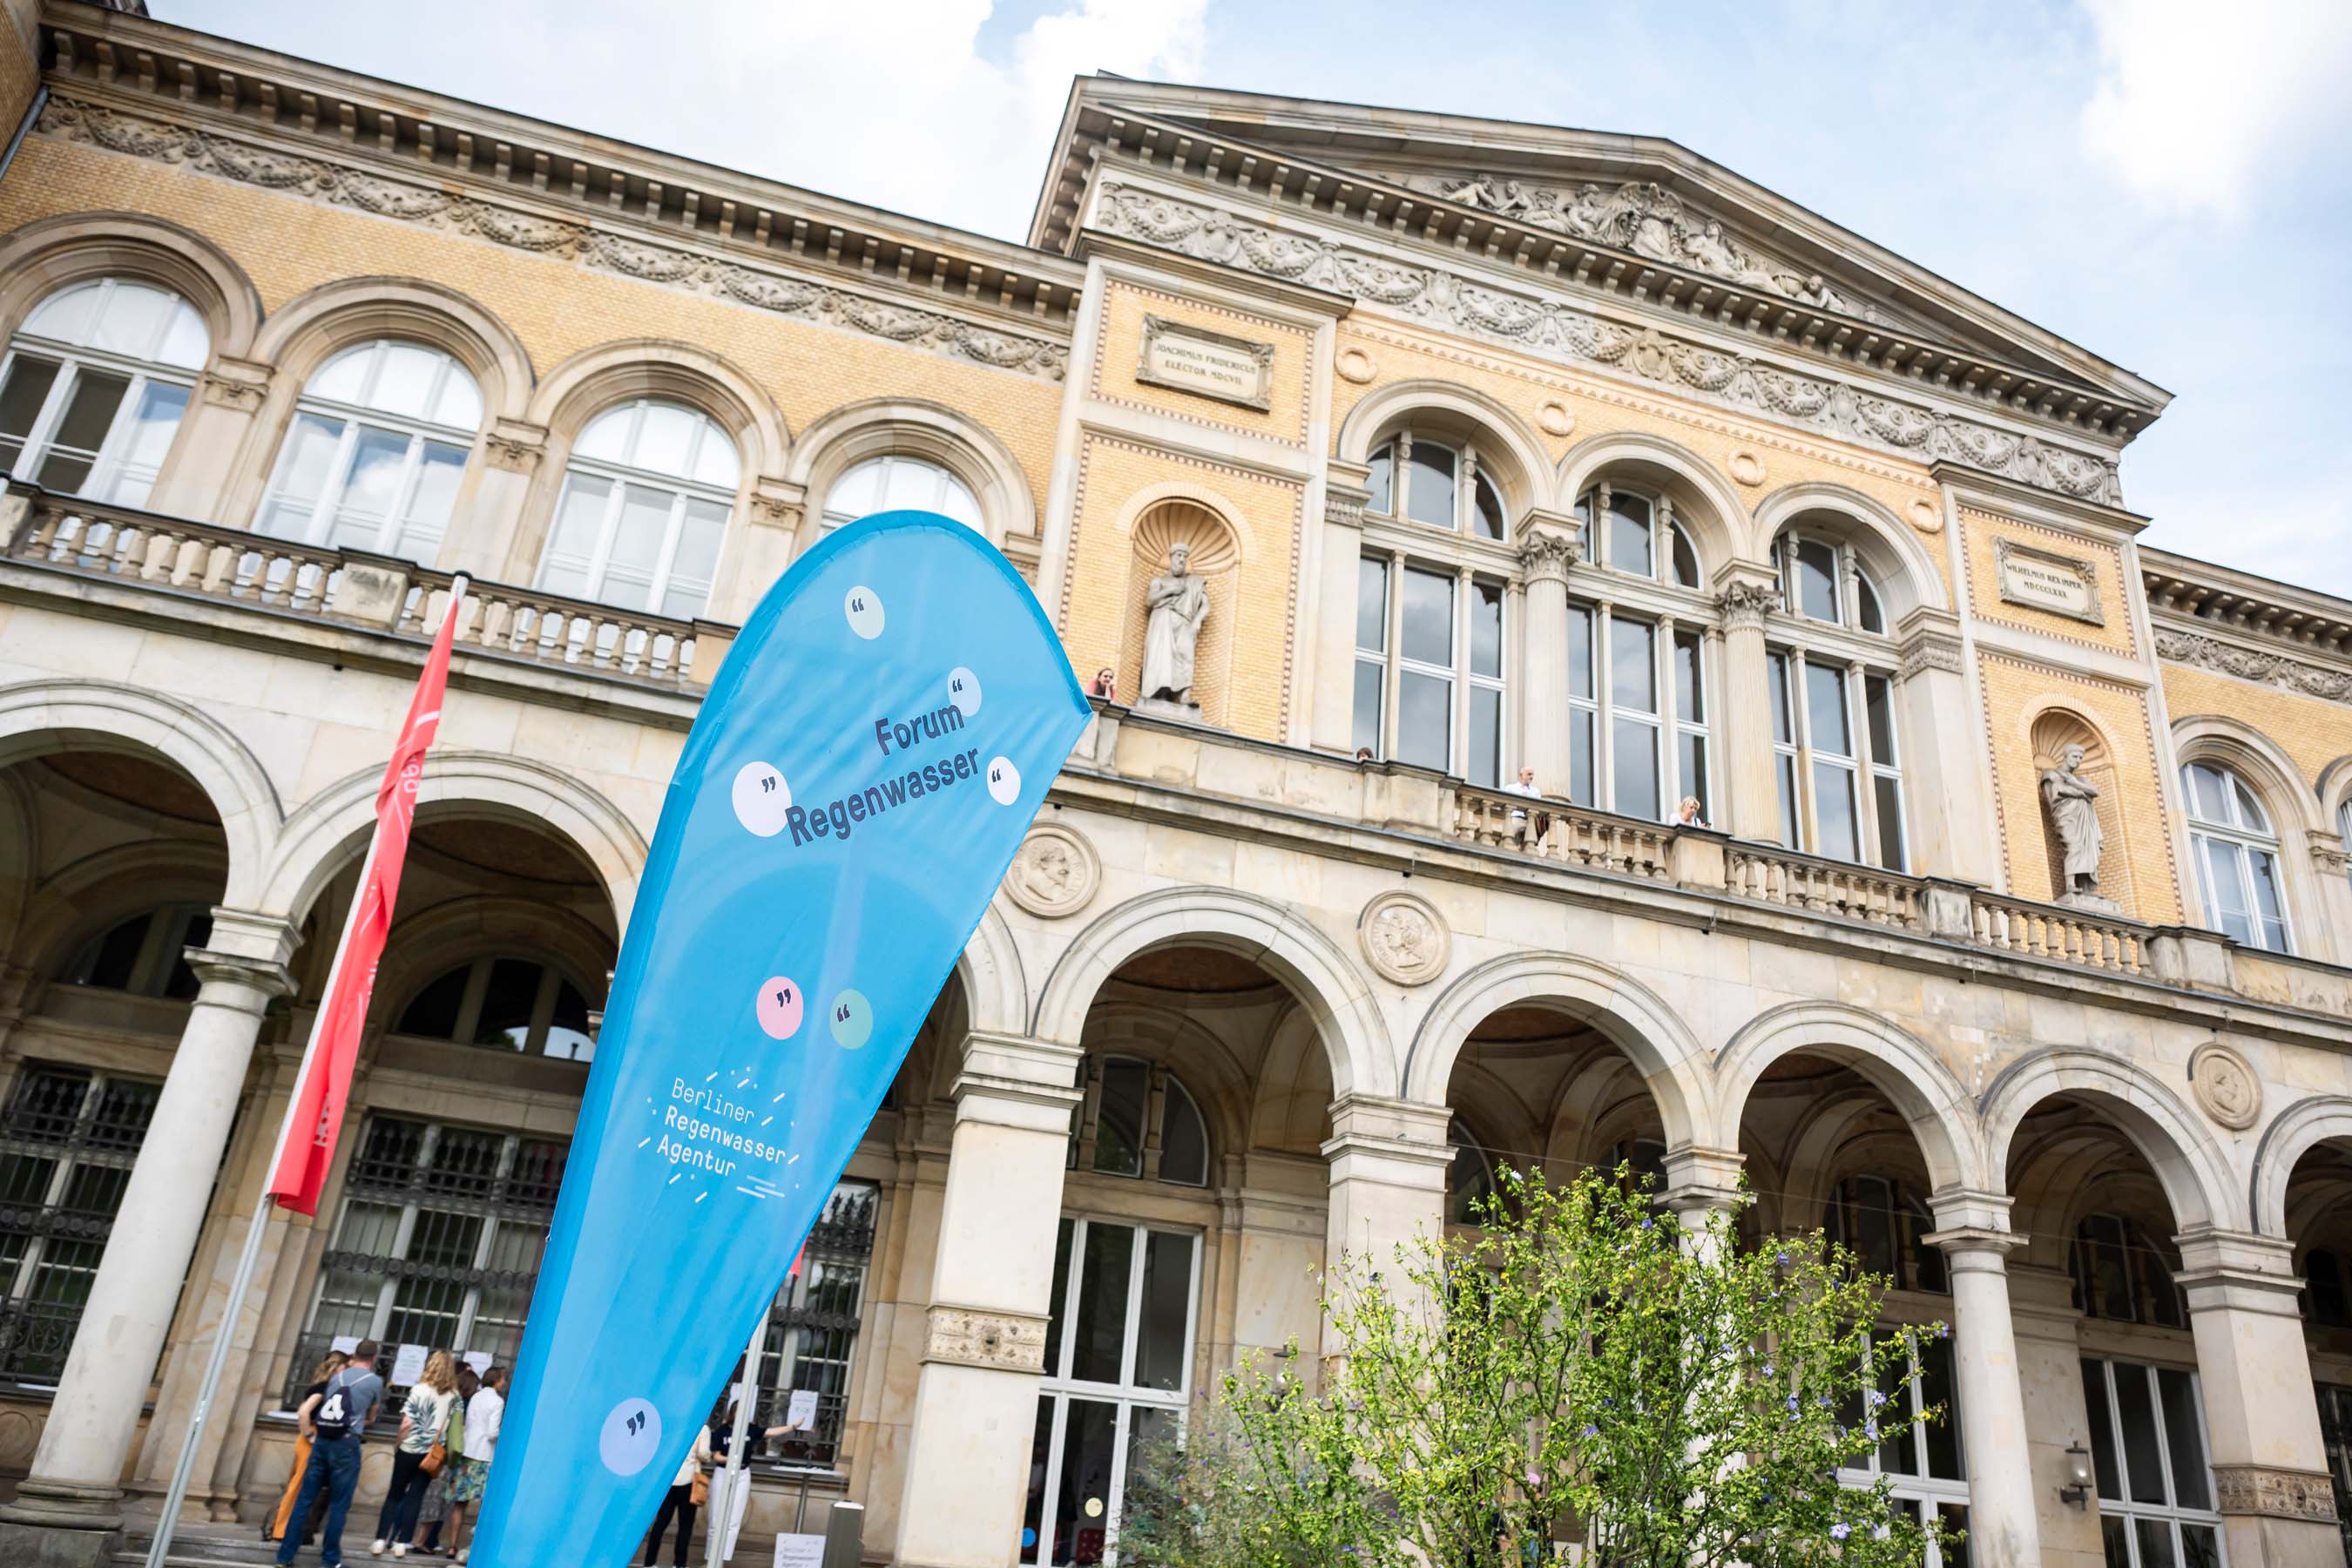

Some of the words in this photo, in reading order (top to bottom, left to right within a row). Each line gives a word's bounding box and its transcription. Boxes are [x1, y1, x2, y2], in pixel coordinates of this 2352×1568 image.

[1165, 360, 1206, 376] ELECTOR
[2005, 563, 2045, 580] WILHELMUS
[2047, 574, 2061, 585] REX
[875, 704, 965, 756] Forum
[785, 747, 979, 847] Regenwasser
[672, 1077, 755, 1125] Berliner
[656, 1133, 736, 1177] Agentur
[664, 1105, 786, 1165] Regenwasser
